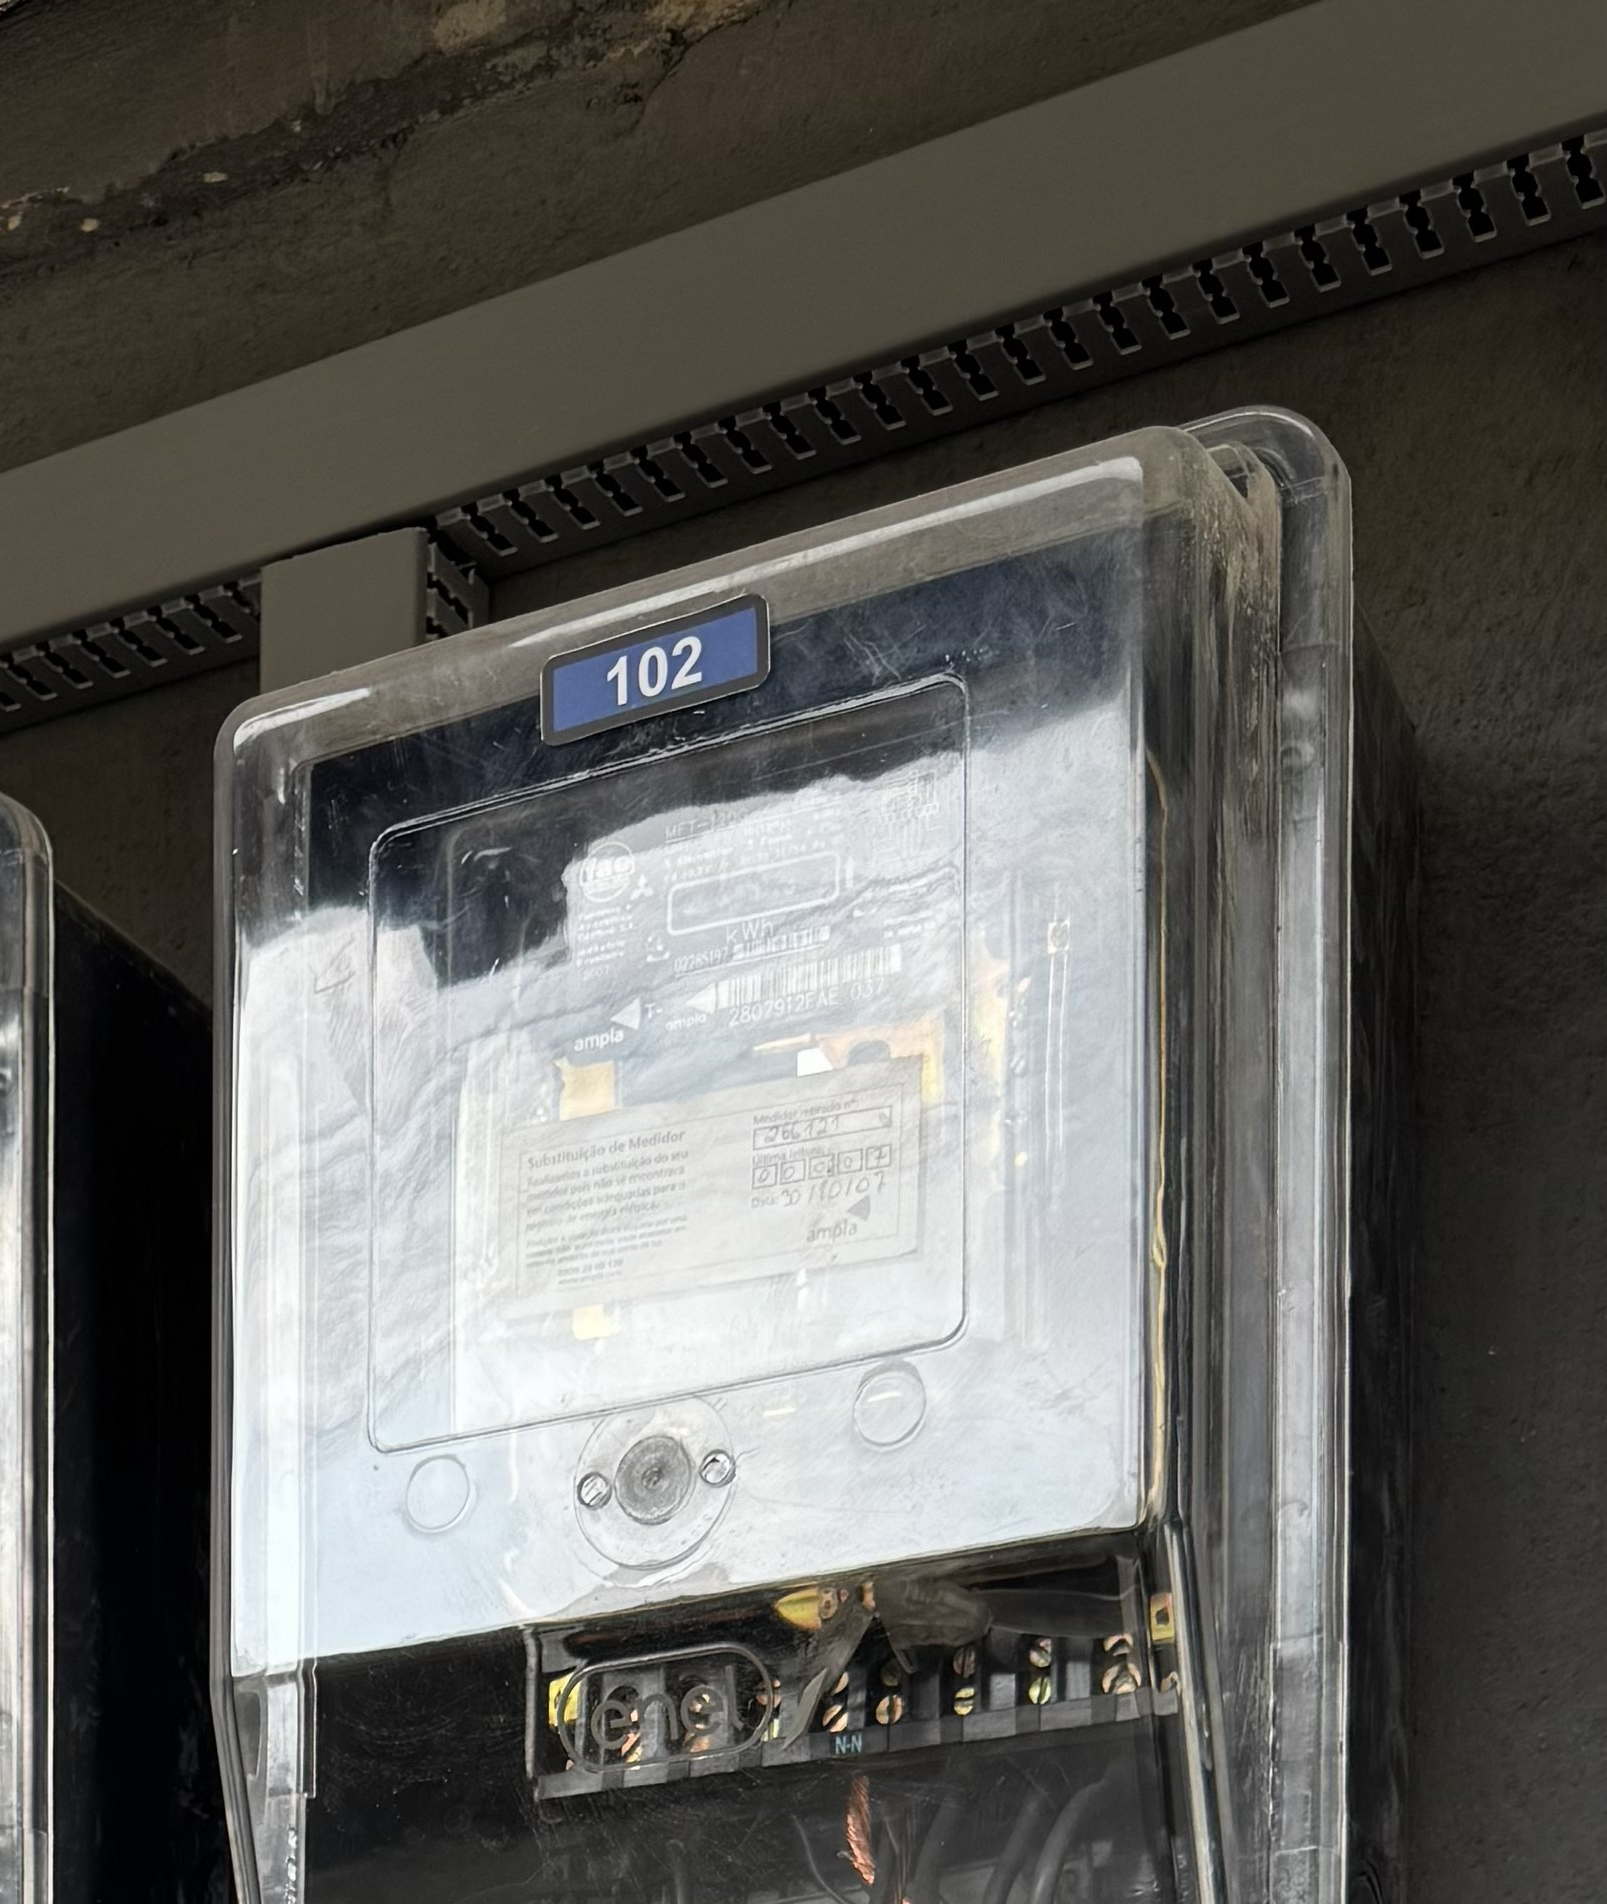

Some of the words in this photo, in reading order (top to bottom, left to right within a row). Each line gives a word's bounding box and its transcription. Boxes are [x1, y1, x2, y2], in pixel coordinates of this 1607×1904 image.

[608, 637, 702, 706] 102
[574, 1029, 625, 1053] ampla
[527, 1146, 606, 1171] Substituição
[609, 1141, 626, 1153] de
[628, 1131, 686, 1150] Medidor
[806, 1218, 858, 1243] ampla
[591, 1664, 745, 1751] enel
